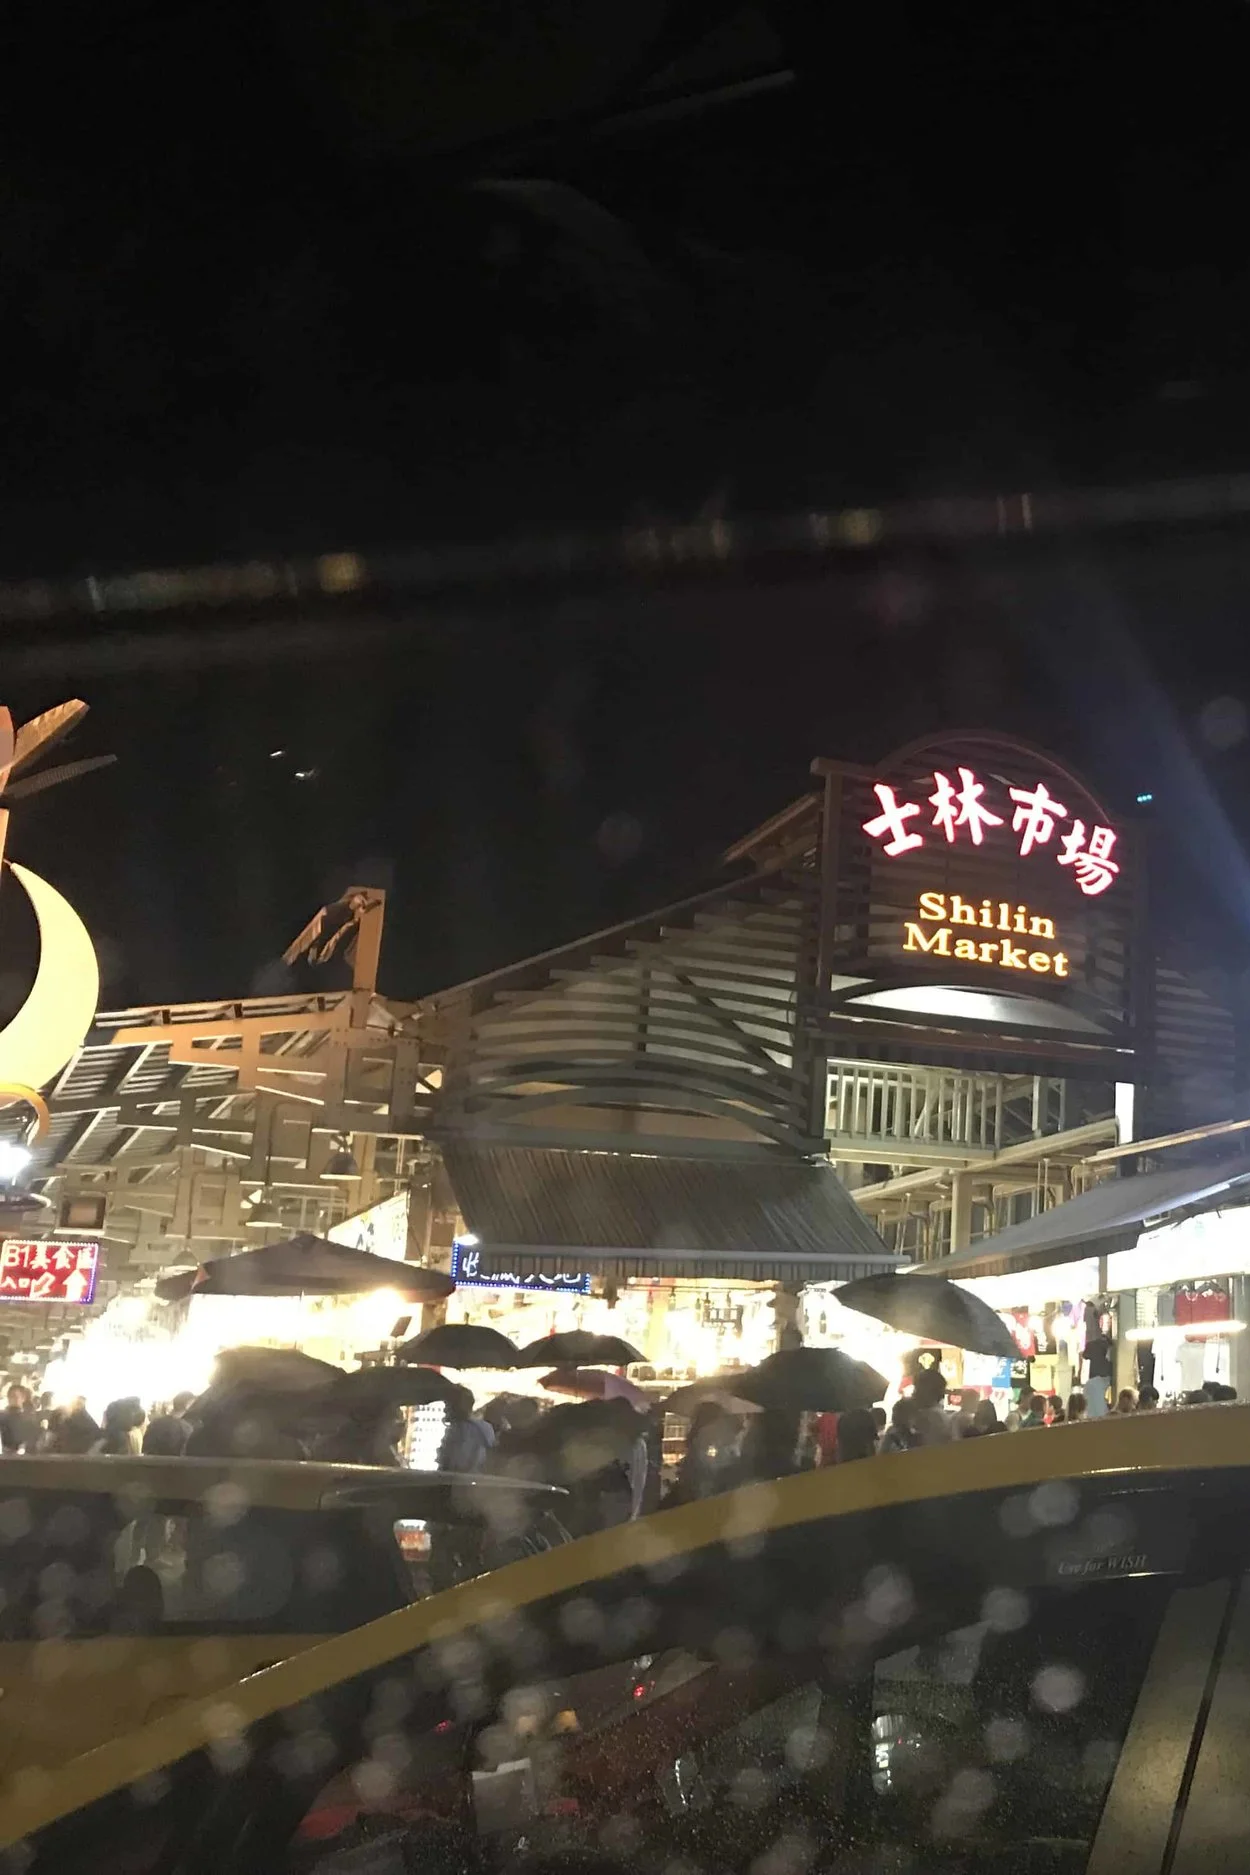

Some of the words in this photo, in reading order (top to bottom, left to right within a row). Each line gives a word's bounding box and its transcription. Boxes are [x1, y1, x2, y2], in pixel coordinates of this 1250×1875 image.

[862, 767, 1120, 896] 士林市場
[919, 892, 1055, 940] Shilin
[903, 922, 1069, 977] Market
[1107, 1554, 1148, 1570] WISH
